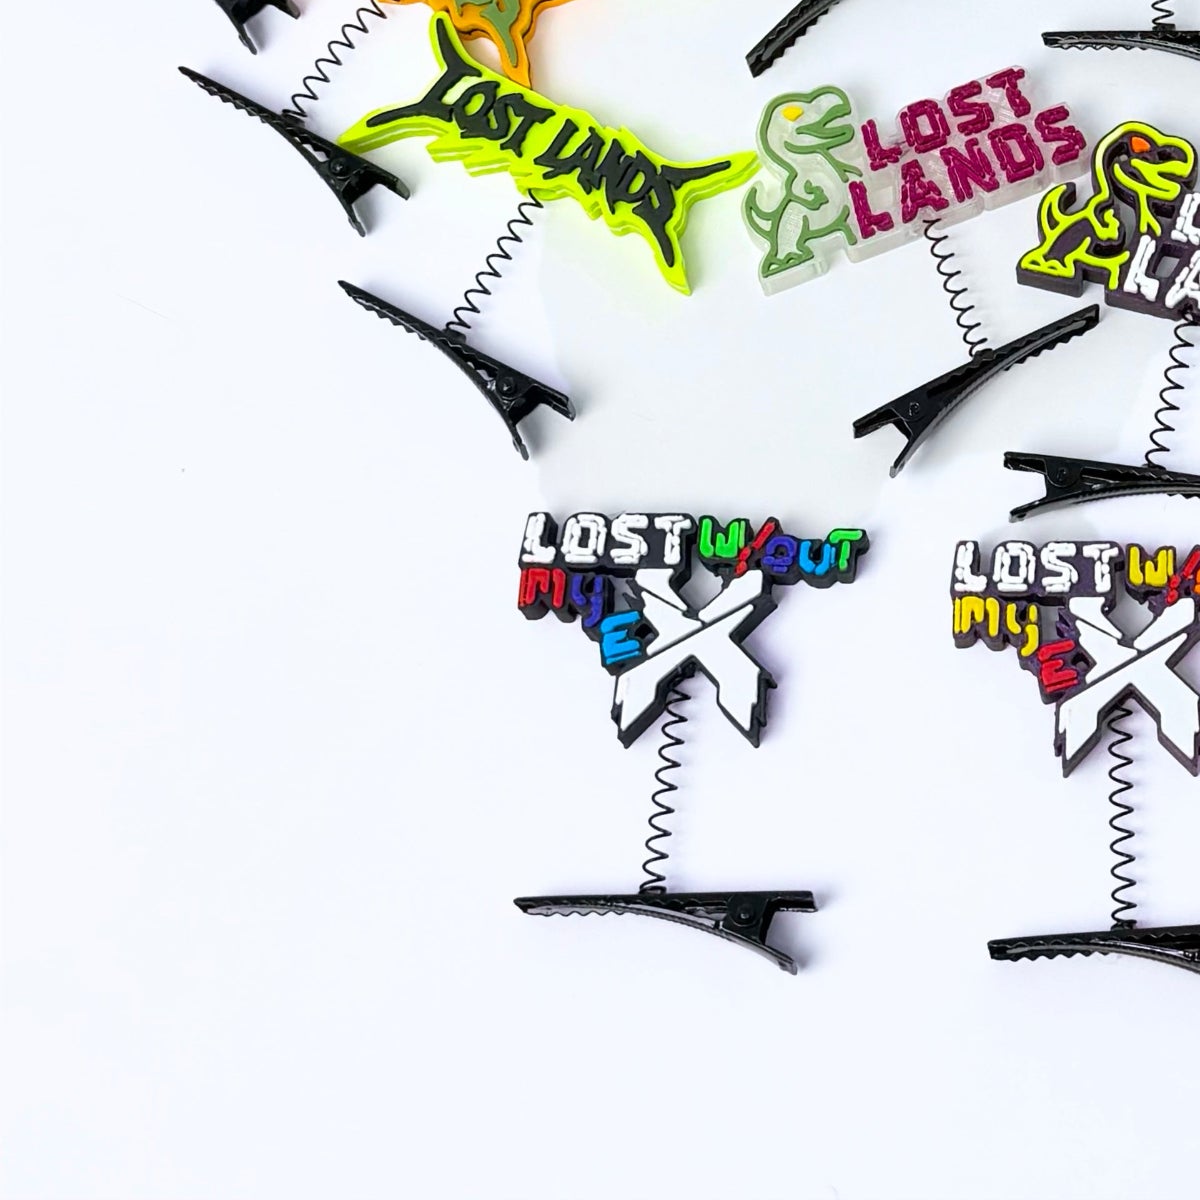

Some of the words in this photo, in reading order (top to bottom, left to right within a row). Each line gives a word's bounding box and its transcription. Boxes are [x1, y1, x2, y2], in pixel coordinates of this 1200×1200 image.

[366, 18, 555, 157] LOST
[534, 118, 731, 267] LANDS
[849, 104, 1088, 238] LANDS
[861, 67, 1032, 171] LOST
[521, 513, 692, 566] LOST
[953, 541, 1119, 593] LOST
